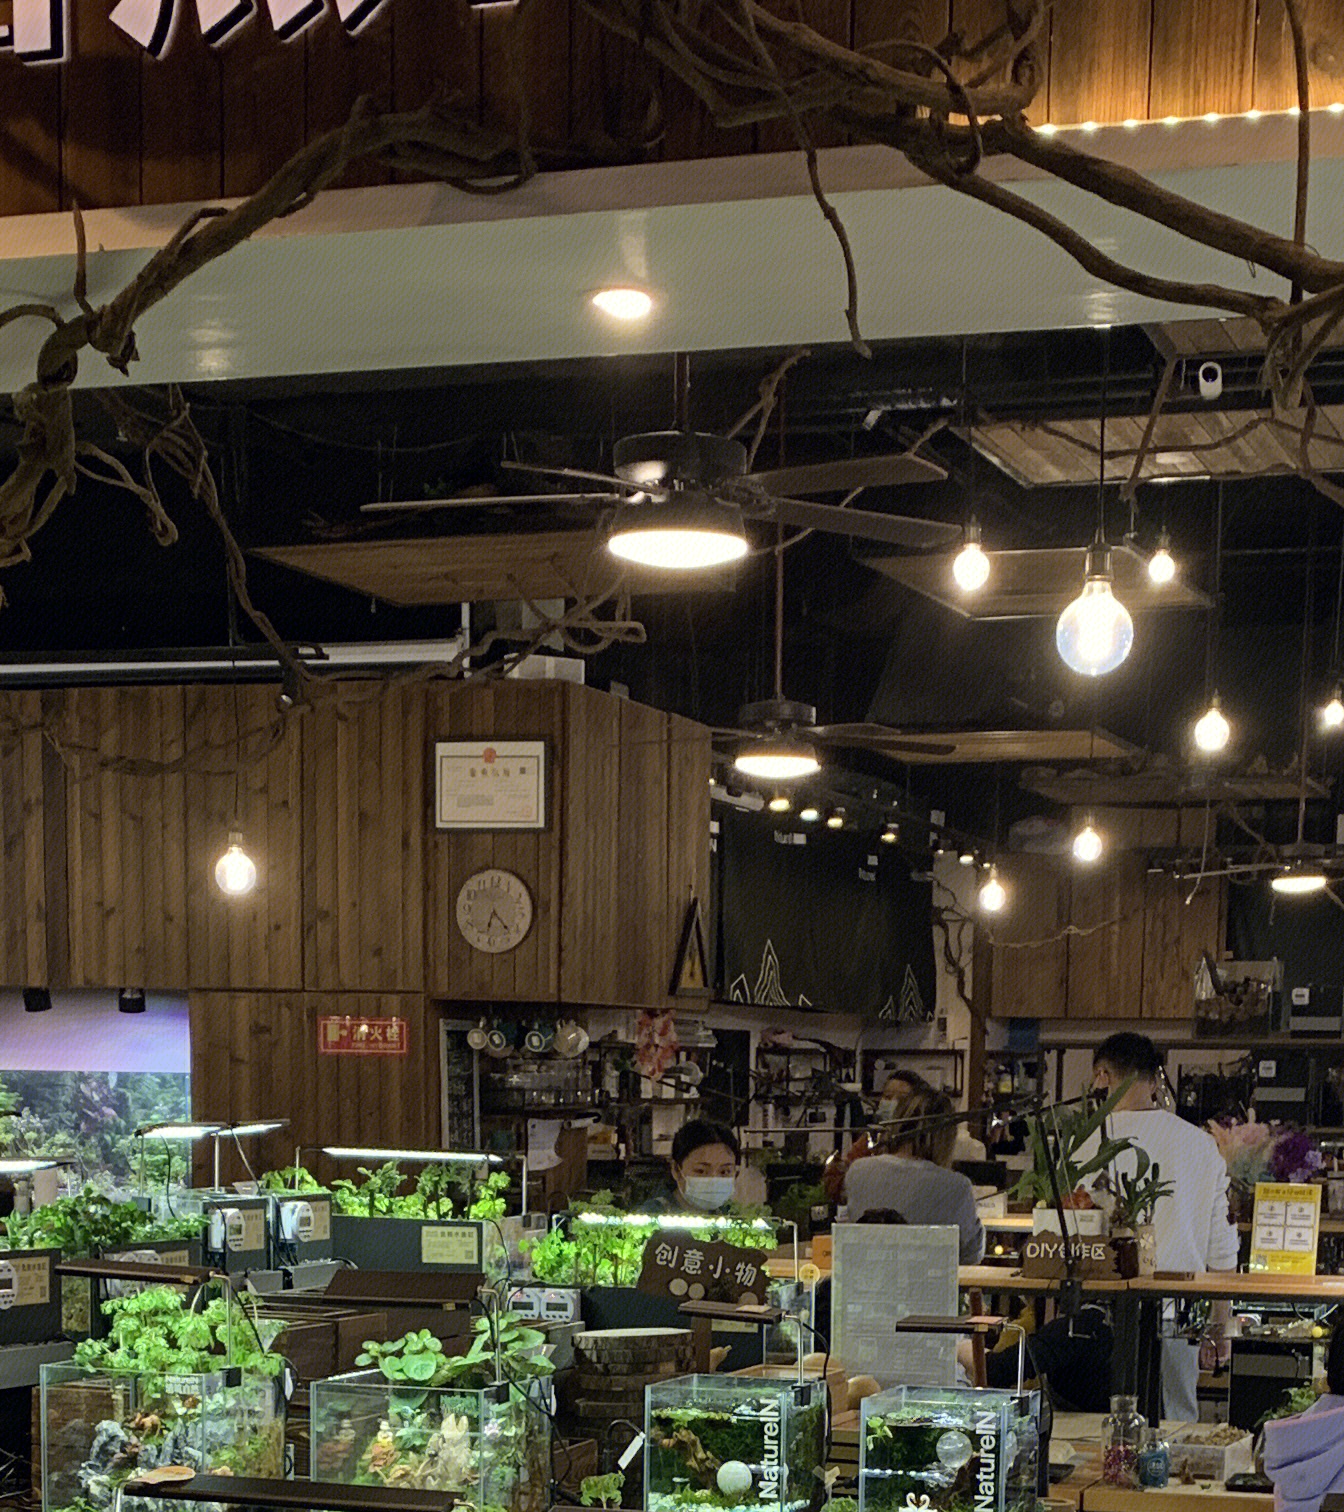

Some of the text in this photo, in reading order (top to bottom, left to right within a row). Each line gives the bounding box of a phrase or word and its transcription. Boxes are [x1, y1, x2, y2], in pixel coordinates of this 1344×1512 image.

[655, 1242, 757, 1287] 创意小物
[758, 1398, 780, 1499] NatureIN
